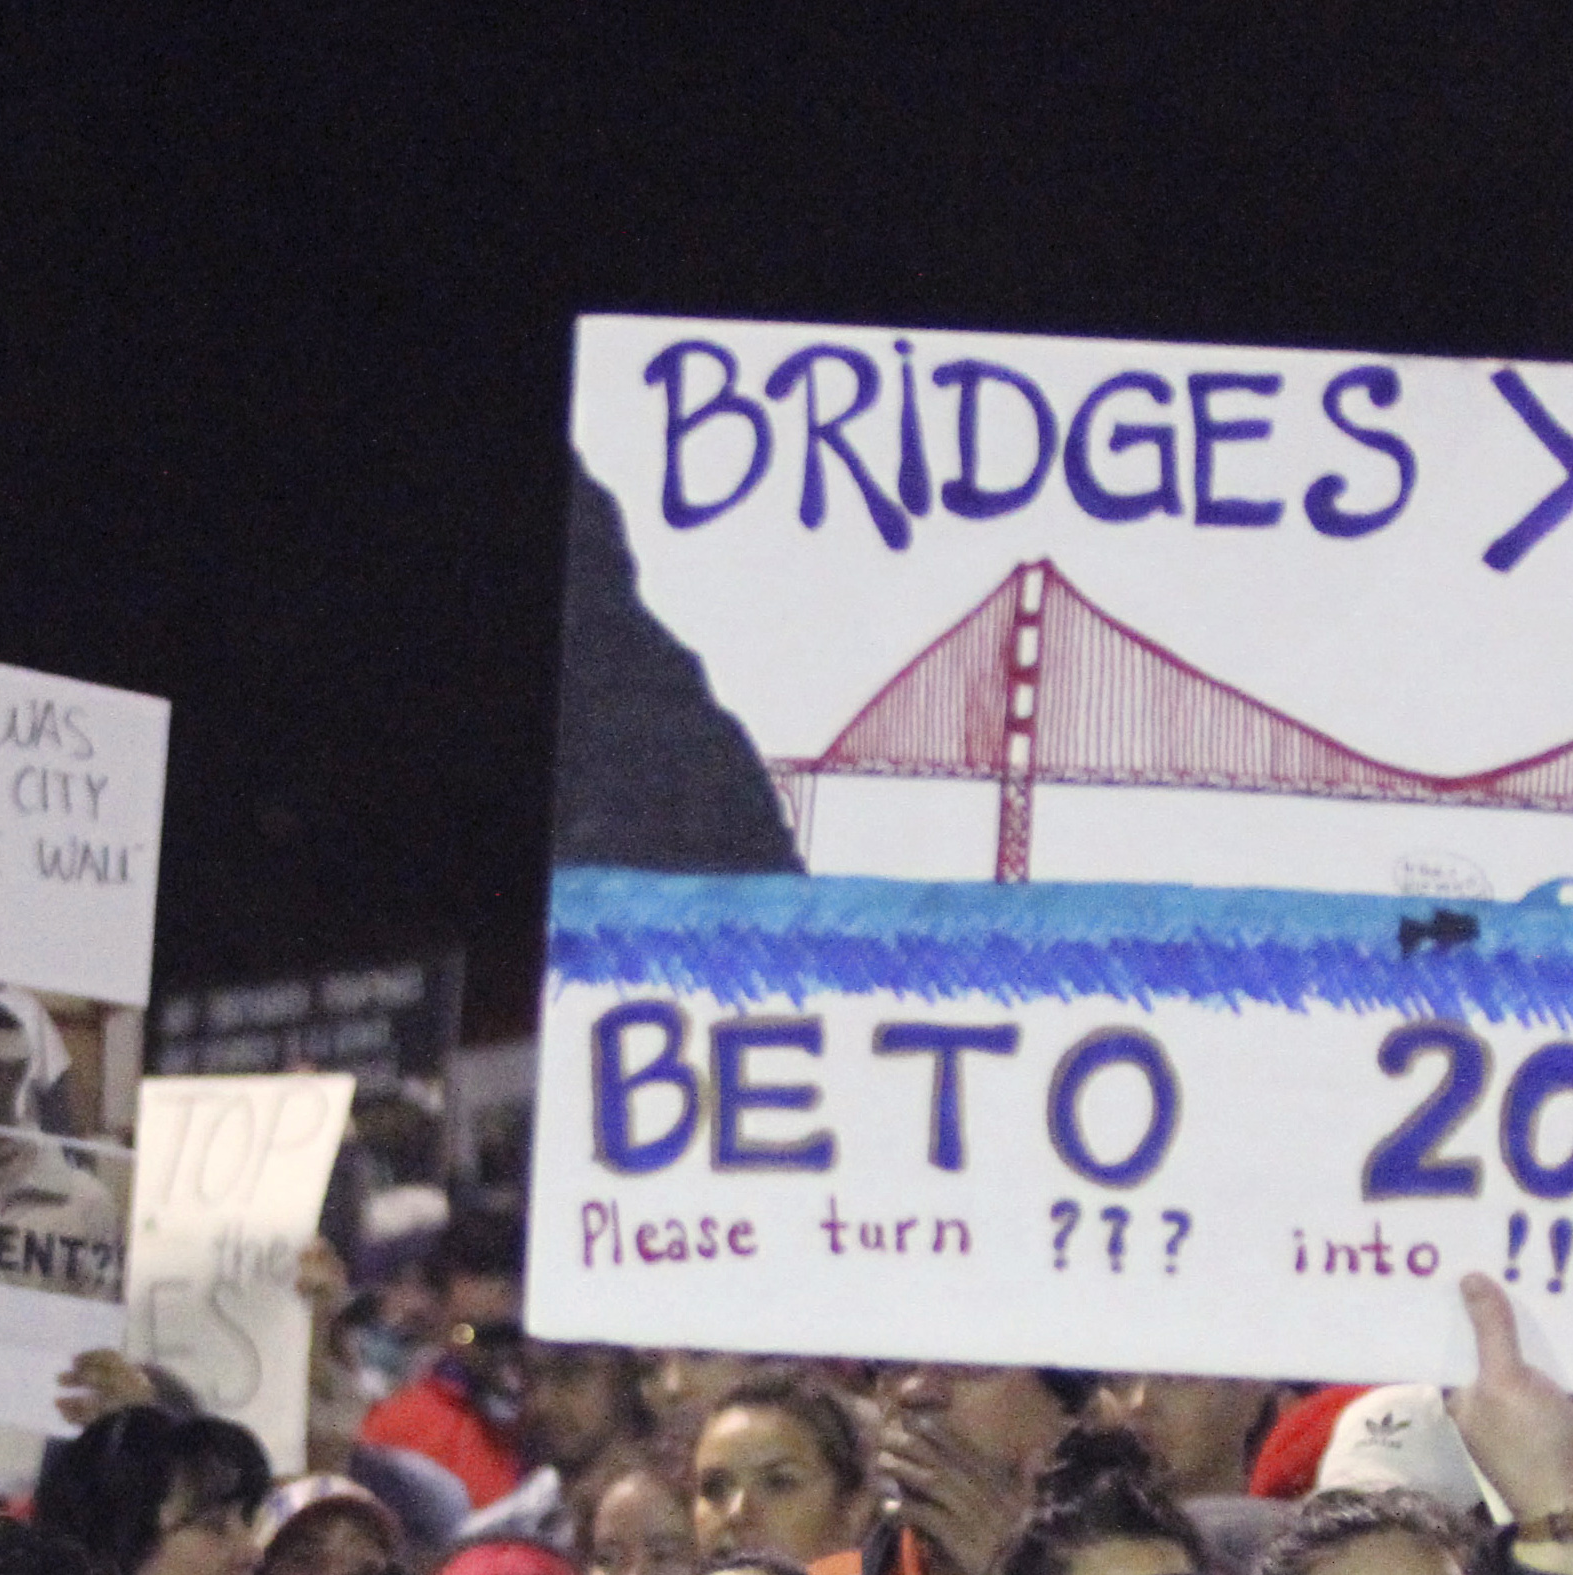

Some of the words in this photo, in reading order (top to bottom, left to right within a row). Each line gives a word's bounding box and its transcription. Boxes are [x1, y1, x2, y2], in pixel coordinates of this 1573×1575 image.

[14, 766, 111, 820] CITY
[590, 999, 1184, 1191] BETO
[581, 1200, 758, 1269] Please
[819, 1195, 972, 1256] turn
[1048, 1198, 1194, 1274] ???
[1291, 1220, 1442, 1277] into
